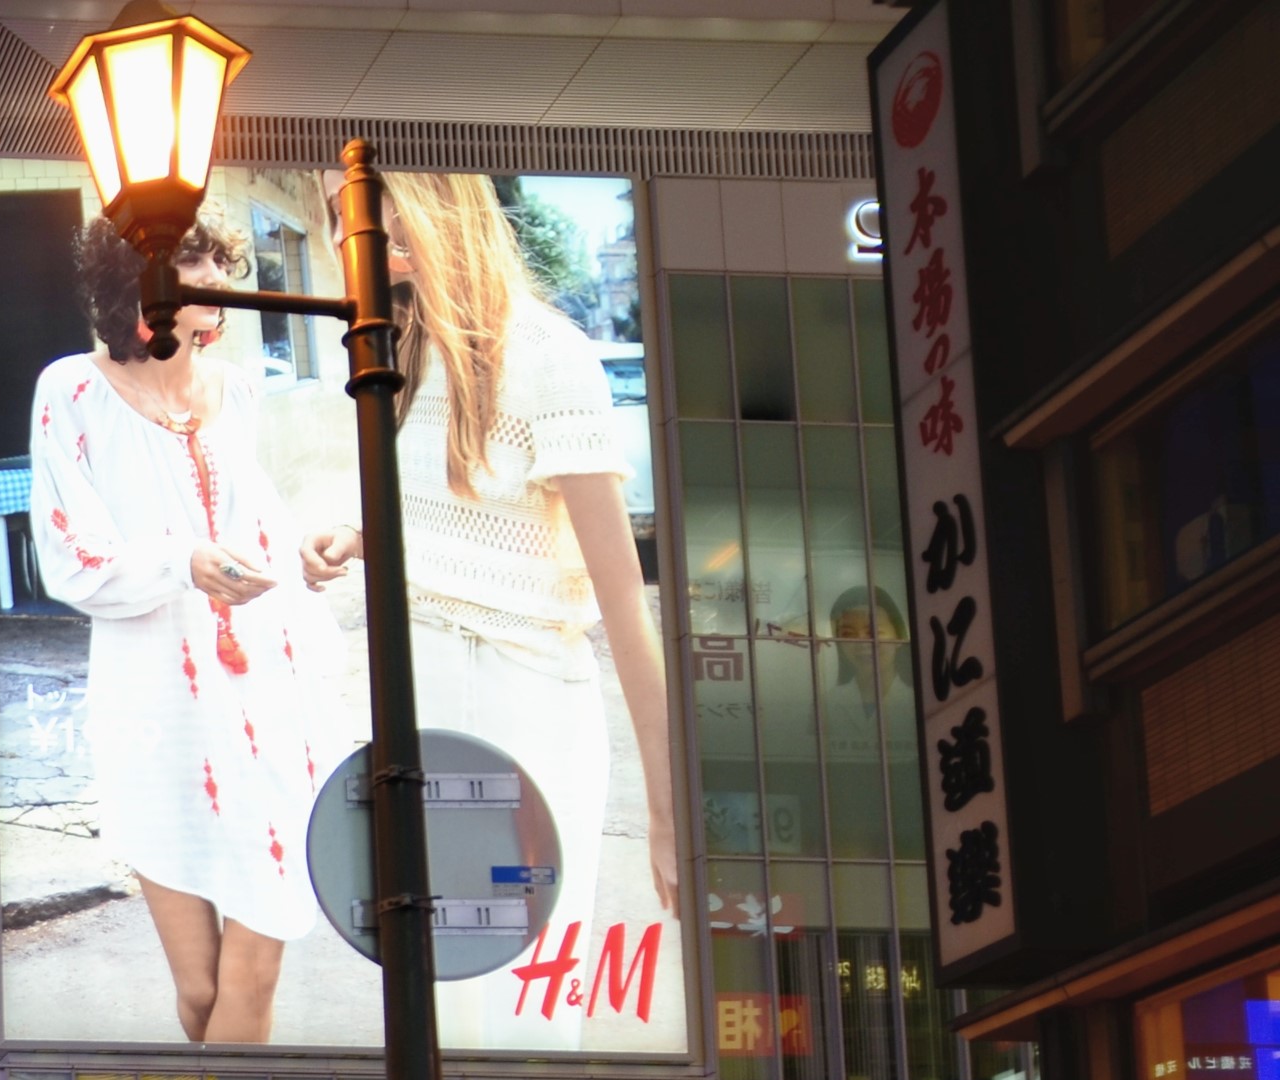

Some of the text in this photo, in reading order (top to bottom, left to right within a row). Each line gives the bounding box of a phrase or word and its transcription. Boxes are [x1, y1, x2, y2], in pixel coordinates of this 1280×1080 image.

[904, 165, 964, 458] 本場の味
[512, 921, 663, 1024] H&M
